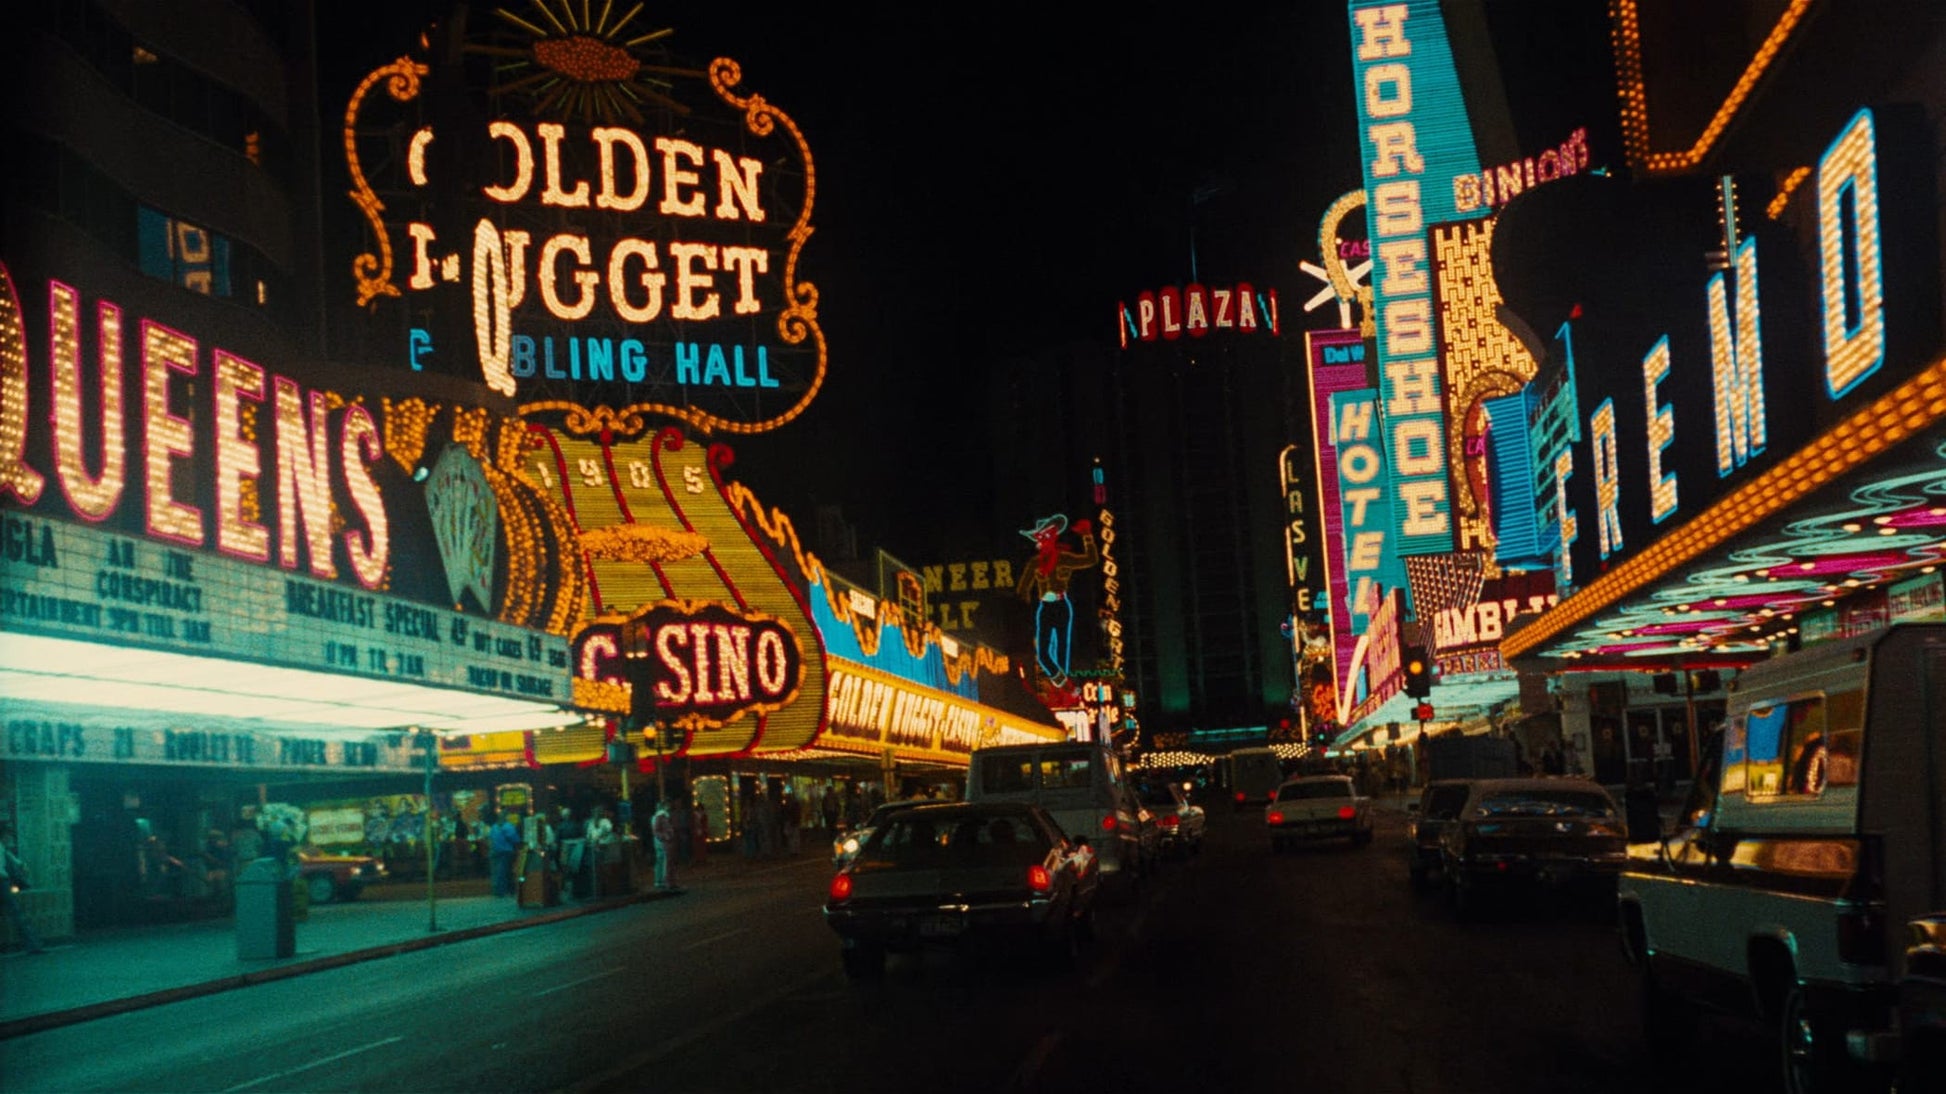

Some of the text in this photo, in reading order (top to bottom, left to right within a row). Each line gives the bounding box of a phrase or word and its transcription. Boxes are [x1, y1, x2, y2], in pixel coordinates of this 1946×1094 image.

[1453, 128, 1588, 213] BINION'S
[1352, 3, 1448, 538] HORSESHOE
[1138, 290, 1257, 337] PLAZA
[409, 328, 780, 388] GBLING HALL
[1287, 461, 1306, 544] LAS
[1334, 402, 1388, 616] HOTEL
[384, 602, 440, 641] SPECIAL
[1099, 508, 1125, 681] GOLDEN GAT
[580, 623, 788, 704] CSINO
